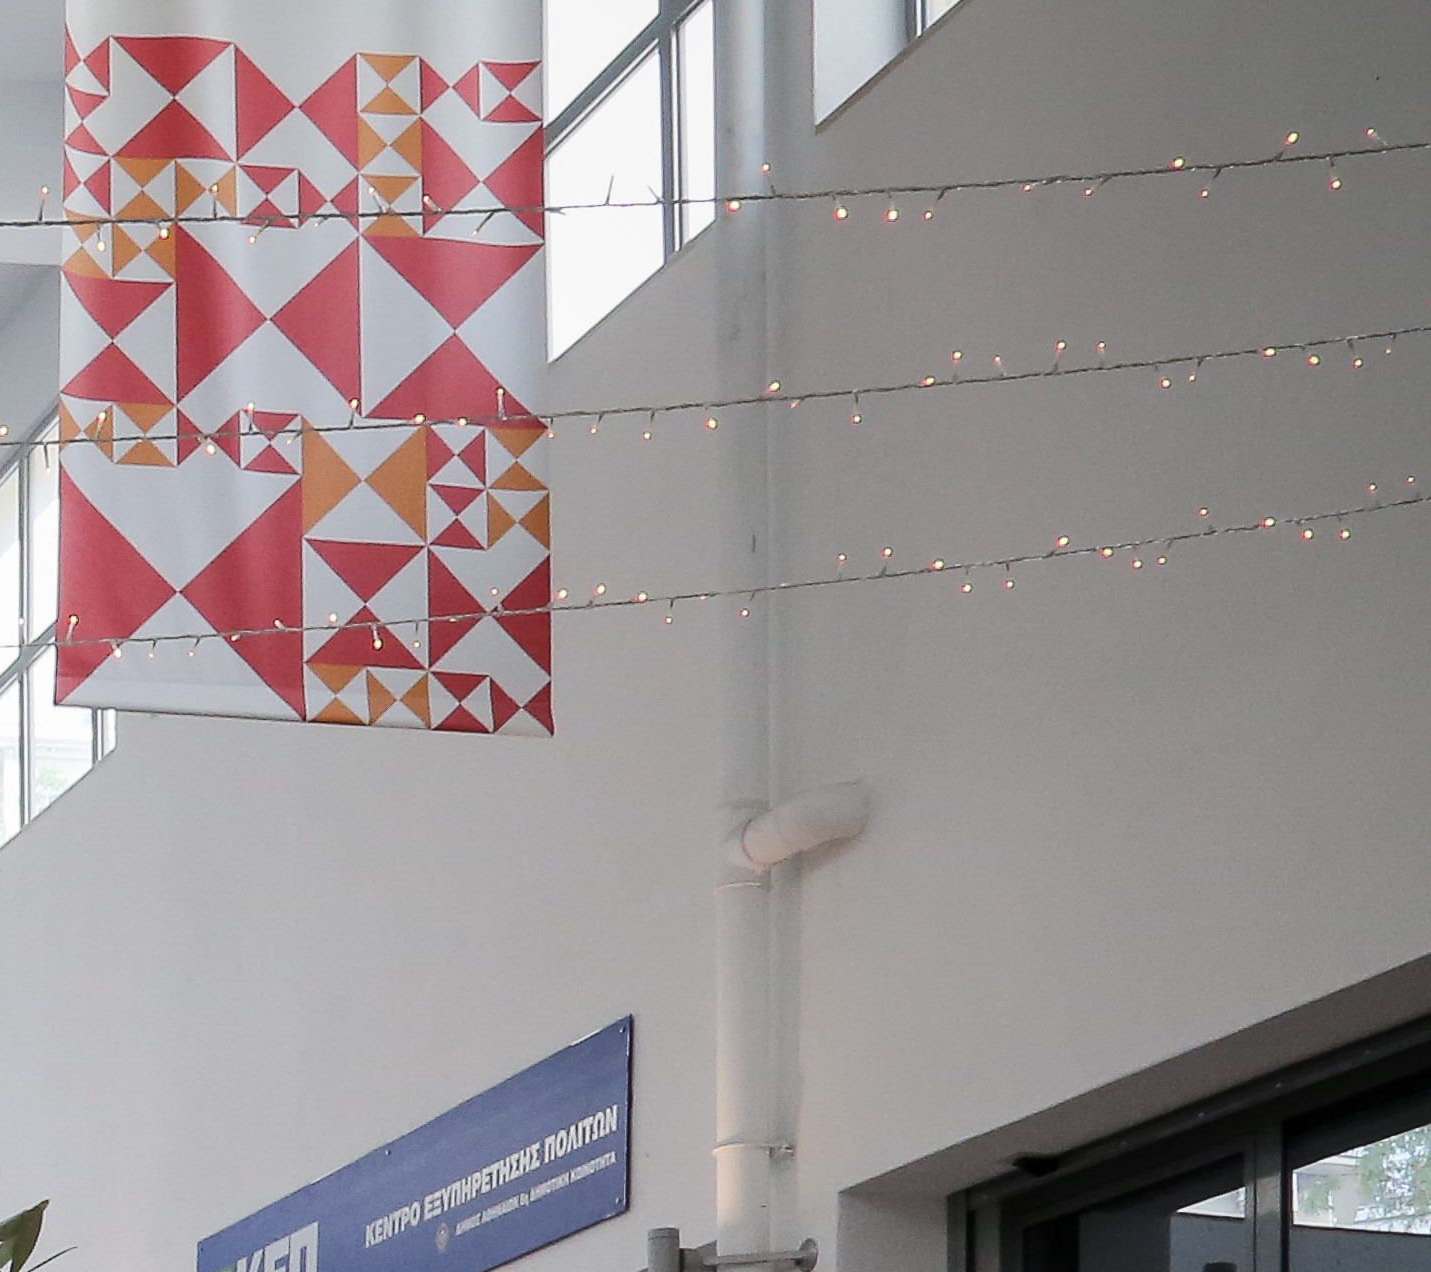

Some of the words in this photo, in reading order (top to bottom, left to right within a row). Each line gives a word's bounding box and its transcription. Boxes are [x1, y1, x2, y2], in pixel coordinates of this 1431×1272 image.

[365, 1201, 421, 1248] ΚΕΝΤΡΟ
[423, 1142, 542, 1221] ΕΞΥΠΗΡΕΤΗΣΗΣ
[544, 1104, 619, 1164] ΠΟΛΙΤΩΝ
